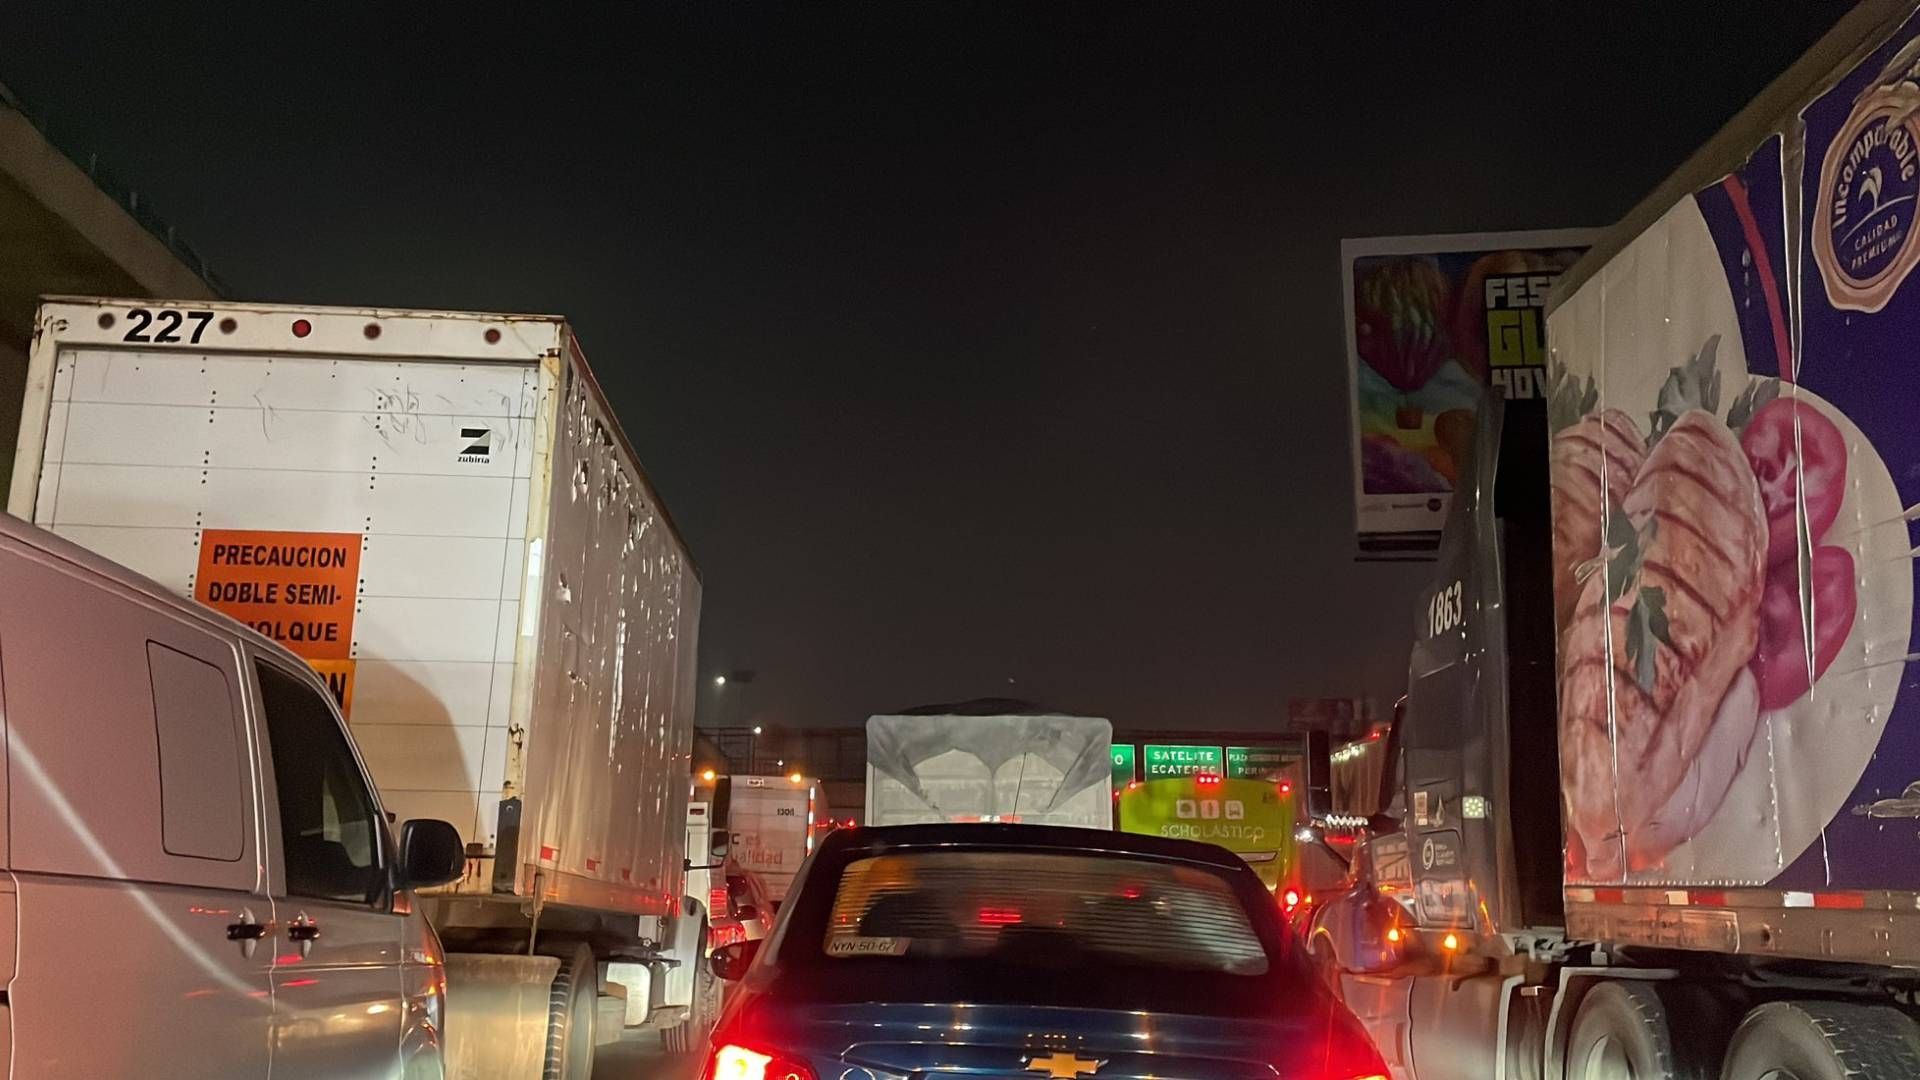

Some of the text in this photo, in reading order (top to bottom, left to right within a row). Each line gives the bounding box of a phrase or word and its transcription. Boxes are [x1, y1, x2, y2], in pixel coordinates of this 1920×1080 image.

[1854, 214, 1898, 251] CALIDAD
[123, 307, 215, 344] 227
[213, 544, 346, 568] PRECAUCION
[208, 581, 342, 605] DOBLE SEMI-
[1428, 580, 1462, 638] 1863
[249, 620, 338, 642] OLQUE
[1153, 751, 1214, 762] SATELITE
[1151, 765, 1217, 775] ECATEPEC
[1160, 823, 1265, 839] SCHOLASTICO
